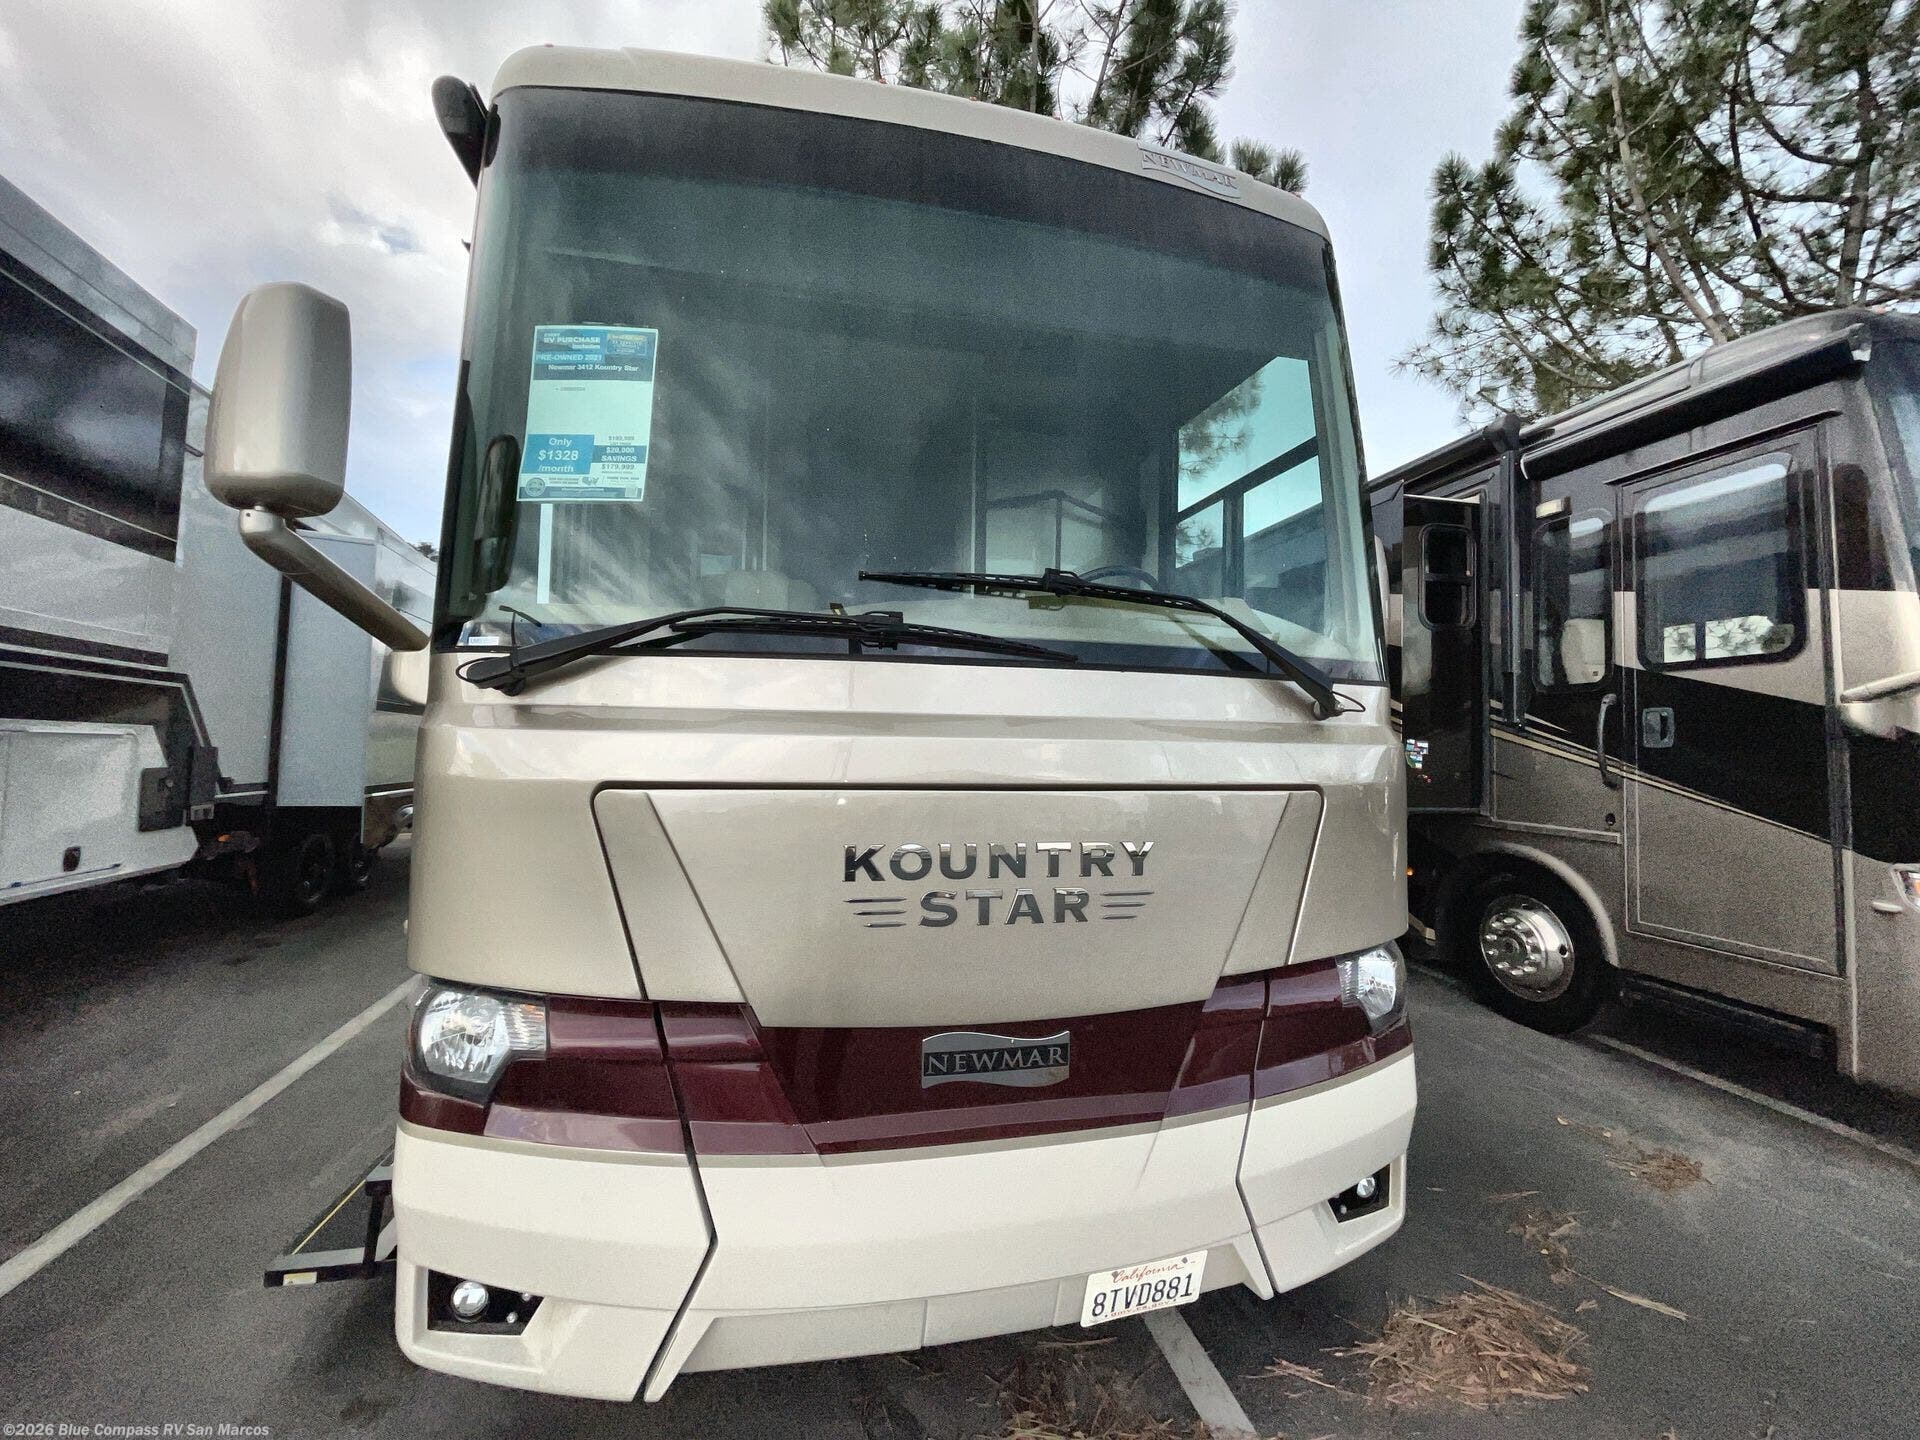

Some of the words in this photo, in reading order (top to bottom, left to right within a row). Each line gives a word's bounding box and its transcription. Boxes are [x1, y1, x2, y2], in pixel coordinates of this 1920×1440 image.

[1142, 152, 1238, 190] NEWMAR
[595, 364, 622, 372] Kountry
[624, 364, 639, 372] Star
[548, 437, 573, 447] Only
[538, 449, 579, 462] $1328
[601, 454, 638, 463] SAVINGS
[538, 463, 574, 473] /month
[842, 841, 1155, 882] KOUNTRY
[918, 886, 1091, 927] STAR
[926, 1046, 1067, 1075] NEWMAR
[1112, 1263, 1184, 1284] California
[1091, 1272, 1193, 1317] 8TVD881
